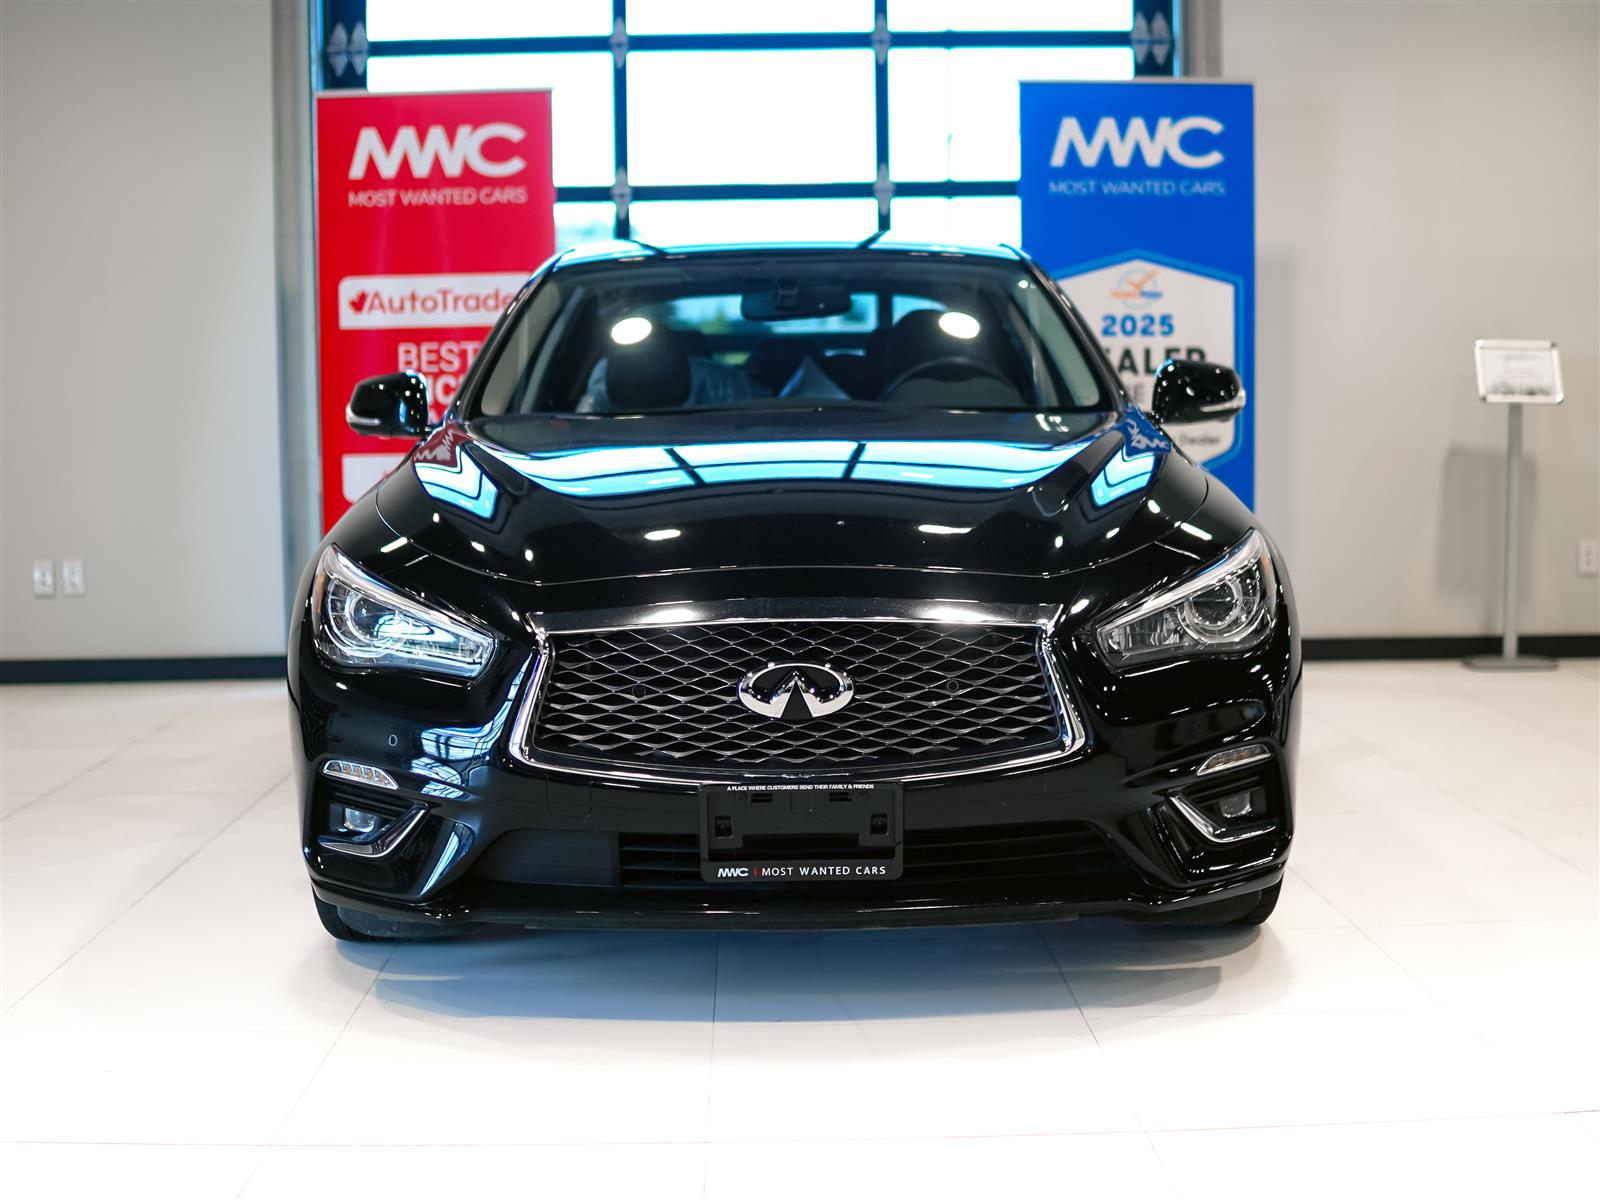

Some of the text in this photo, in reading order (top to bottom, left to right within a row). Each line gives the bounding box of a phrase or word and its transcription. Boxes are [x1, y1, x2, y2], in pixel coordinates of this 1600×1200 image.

[349, 122, 526, 180] MWC
[1050, 116, 1224, 169] MWC
[348, 185, 528, 207] MOST WANTED CARS
[1049, 179, 1225, 196] MOST WANTED CARS
[1101, 314, 1174, 337] 2025
[398, 341, 482, 373] BEST
[717, 866, 886, 878] MWC MOST WANTED CARS
